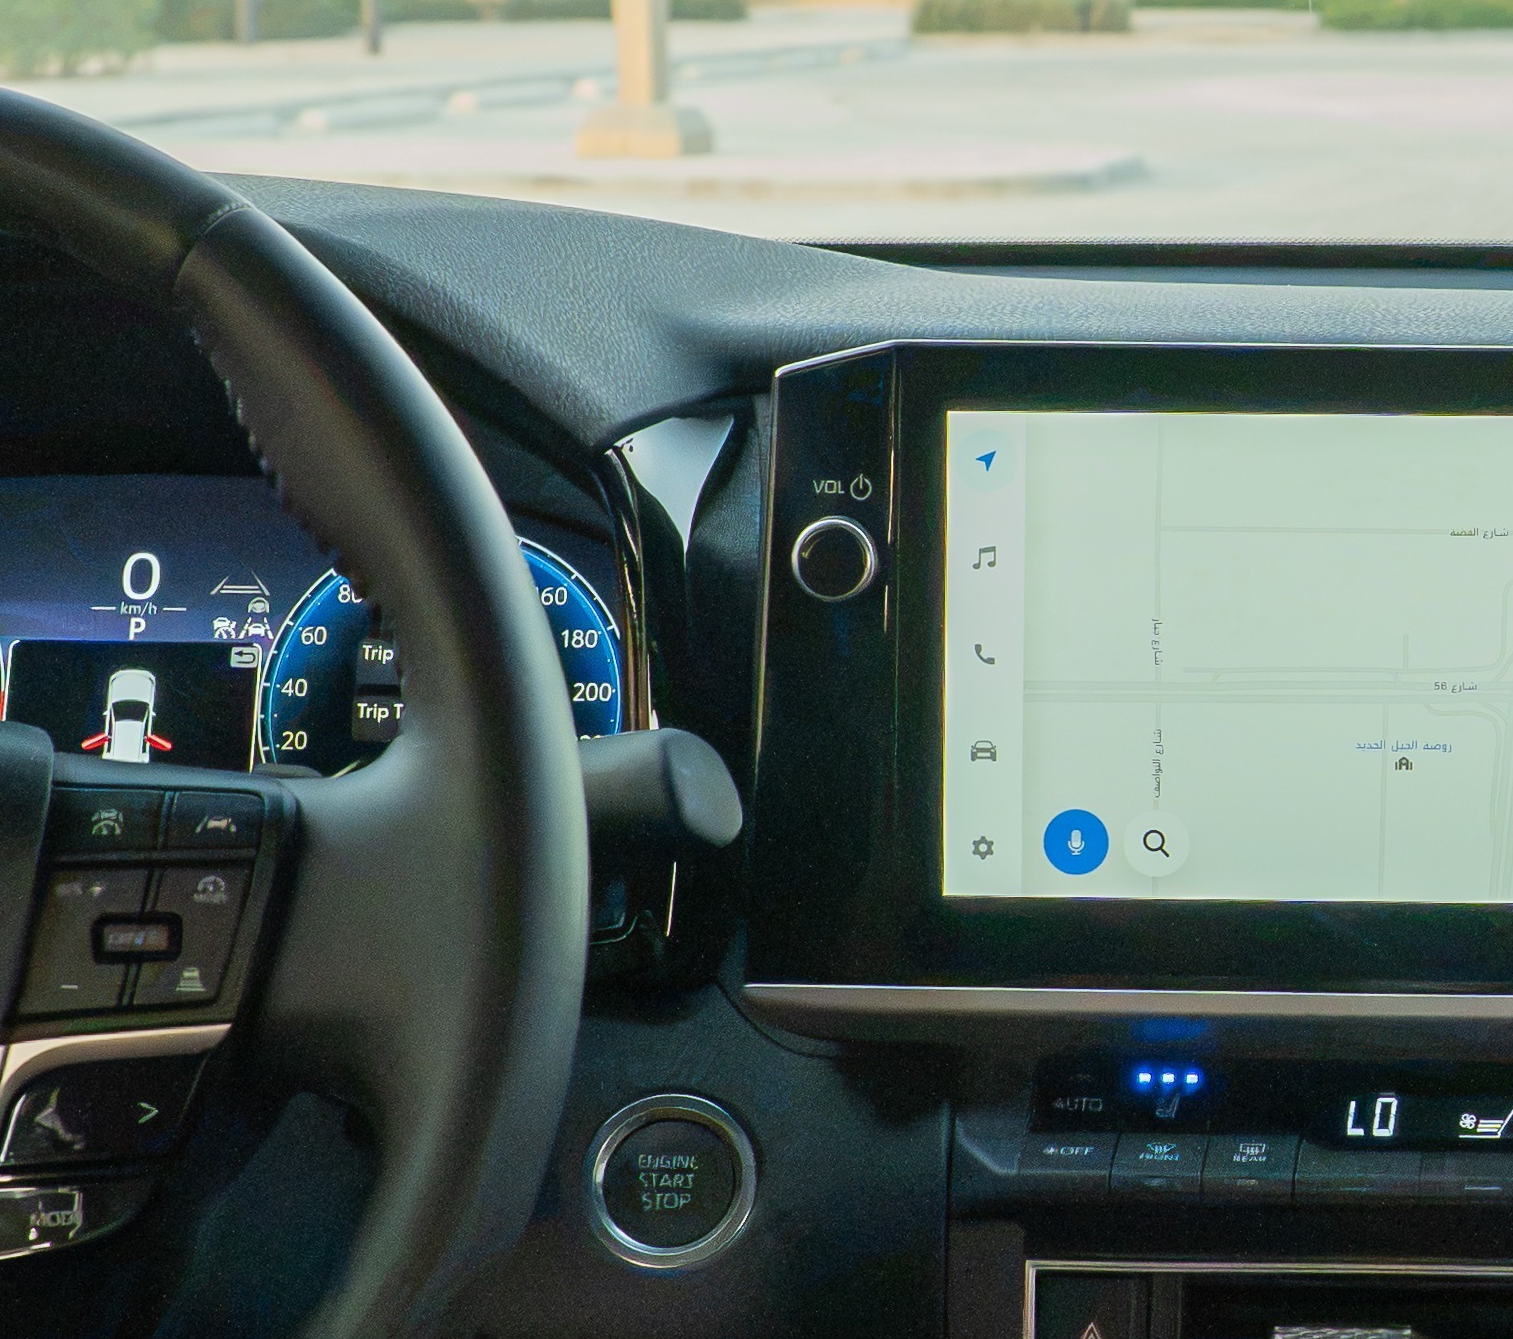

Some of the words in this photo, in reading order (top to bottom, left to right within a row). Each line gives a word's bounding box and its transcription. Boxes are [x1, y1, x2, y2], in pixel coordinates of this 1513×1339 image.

[812, 479, 845, 494] VOL
[121, 552, 161, 600] 0
[535, 586, 568, 606] 60
[119, 601, 158, 617] km/h
[128, 619, 146, 641] P
[301, 626, 327, 646] 60
[562, 630, 598, 649] 180
[362, 644, 394, 664] Trip
[281, 679, 308, 697] 40
[574, 683, 612, 702] 200
[1434, 681, 1447, 691] 56
[357, 702, 389, 724] Trip
[281, 731, 308, 750] 20
[638, 1155, 699, 1170] ENGINE
[638, 1173, 695, 1189] START
[642, 1193, 692, 1210] STOP
